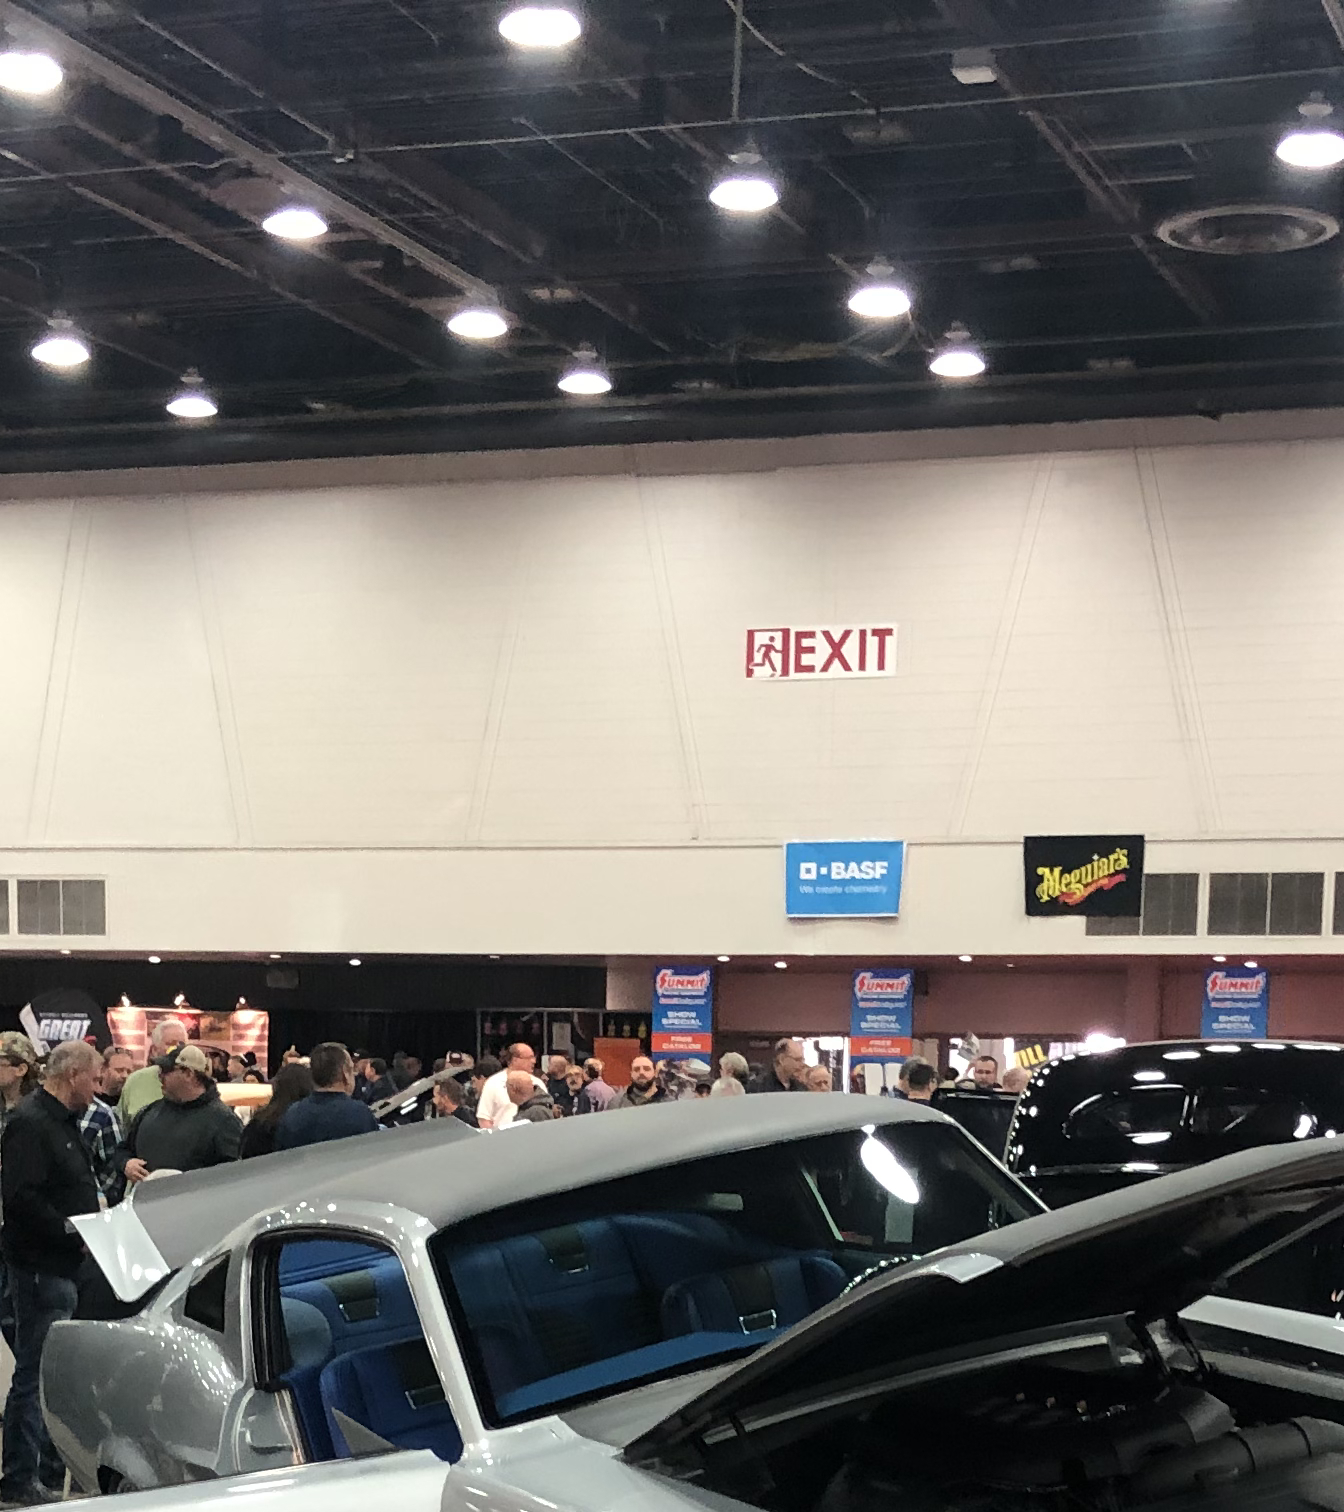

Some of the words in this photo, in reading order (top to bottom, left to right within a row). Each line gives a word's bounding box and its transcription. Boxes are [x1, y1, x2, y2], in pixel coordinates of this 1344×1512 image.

[794, 628, 894, 673] EXIT
[830, 861, 889, 880] BASF
[1036, 848, 1130, 902] Meguiar's
[38, 1019, 92, 1040] GREAT
